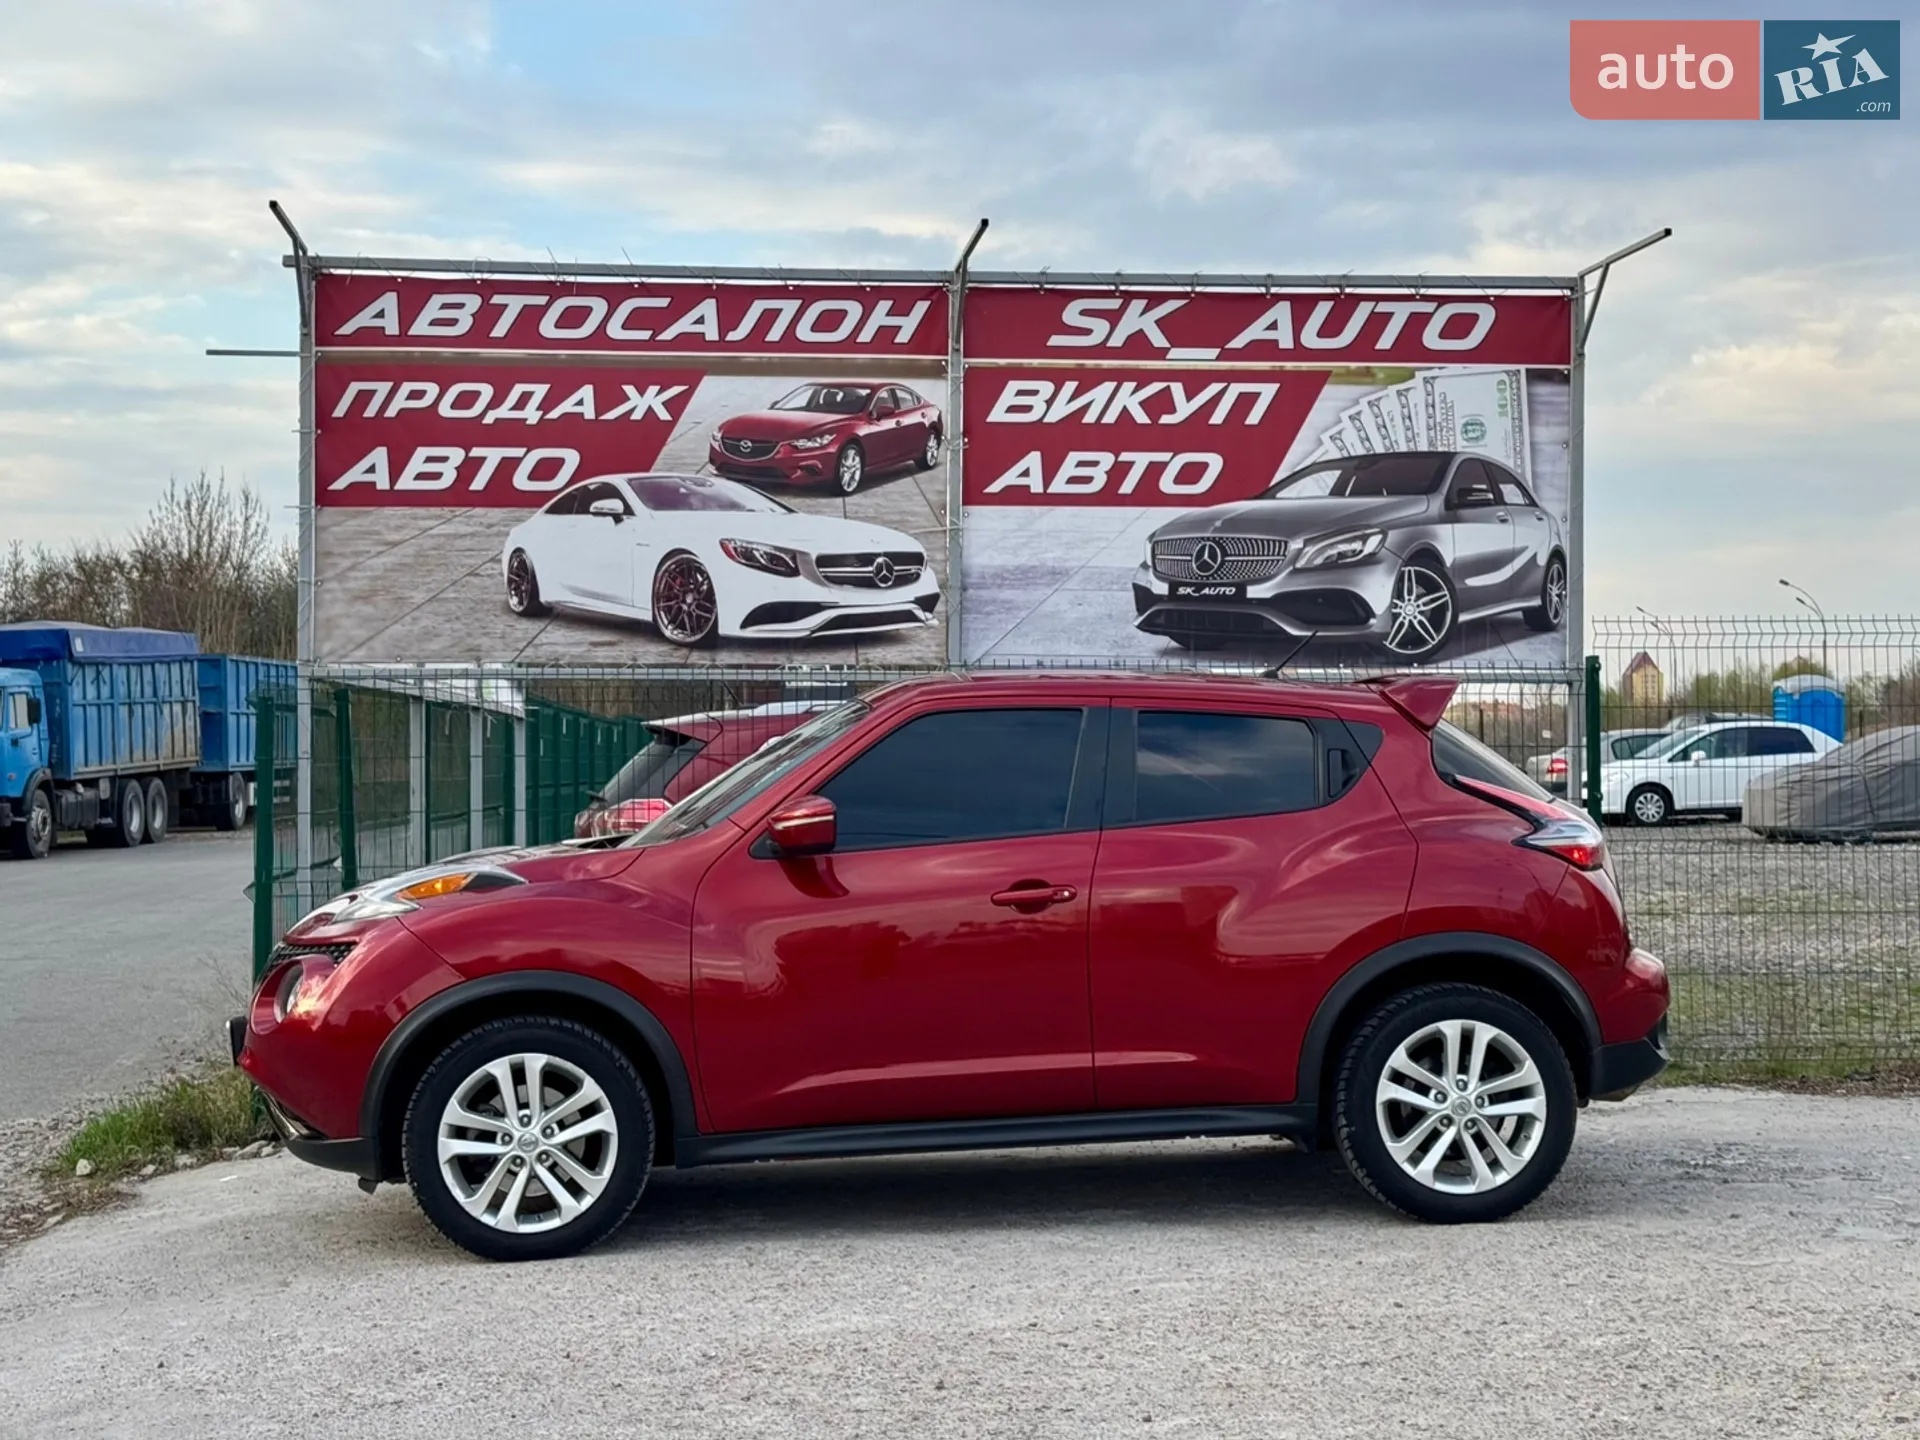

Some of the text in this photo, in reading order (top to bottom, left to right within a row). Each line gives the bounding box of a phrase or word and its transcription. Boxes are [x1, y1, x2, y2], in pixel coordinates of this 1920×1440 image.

[334, 291, 931, 344] АВТОСАЛОН
[1046, 298, 1496, 360] SK_AUTO
[331, 381, 690, 426] ПРОДАЖ
[985, 380, 1281, 426] ВИКУП
[327, 446, 581, 491] АВТО
[982, 450, 1224, 495] АВТО
[1176, 586, 1236, 597] SK_AUTO
